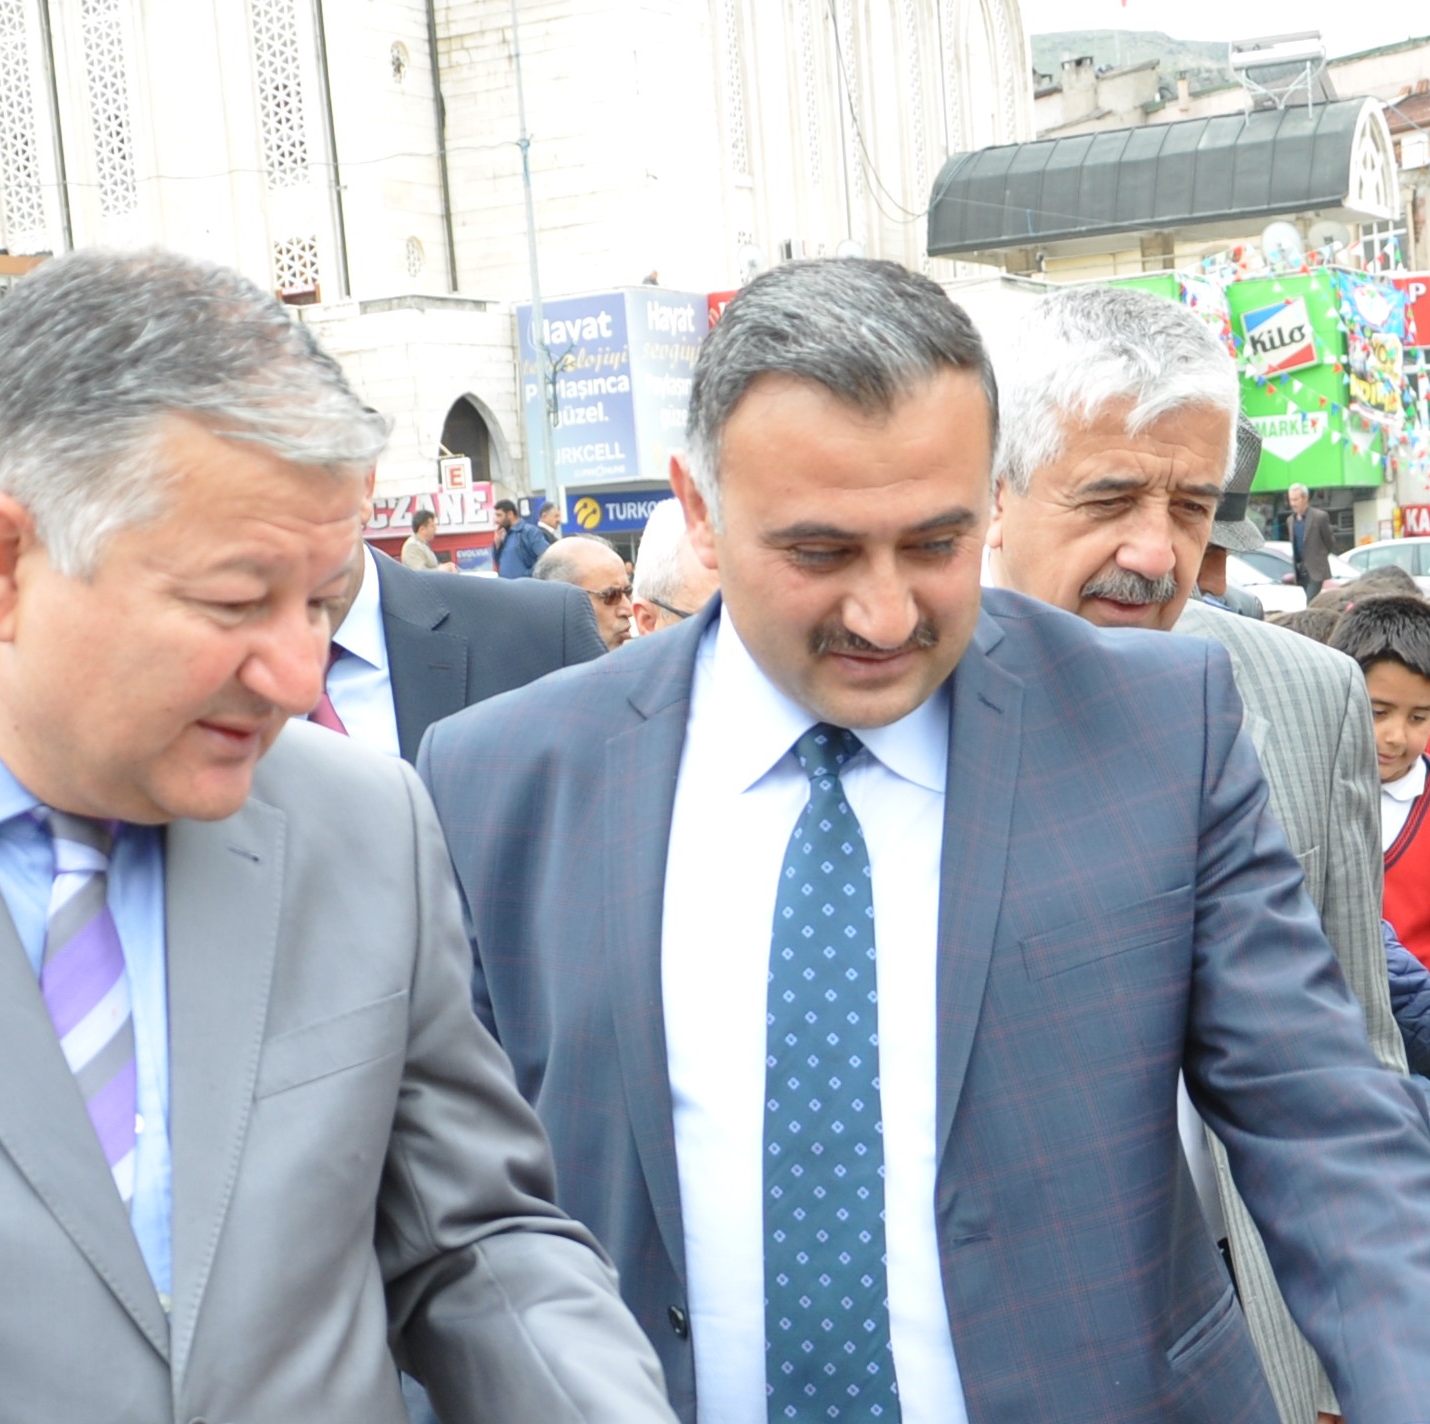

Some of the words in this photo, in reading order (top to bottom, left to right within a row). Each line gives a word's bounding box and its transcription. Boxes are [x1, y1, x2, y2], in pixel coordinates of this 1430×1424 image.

[647, 300, 695, 336] Hayat
[1250, 323, 1307, 356] Kilo
[450, 465, 467, 487] E
